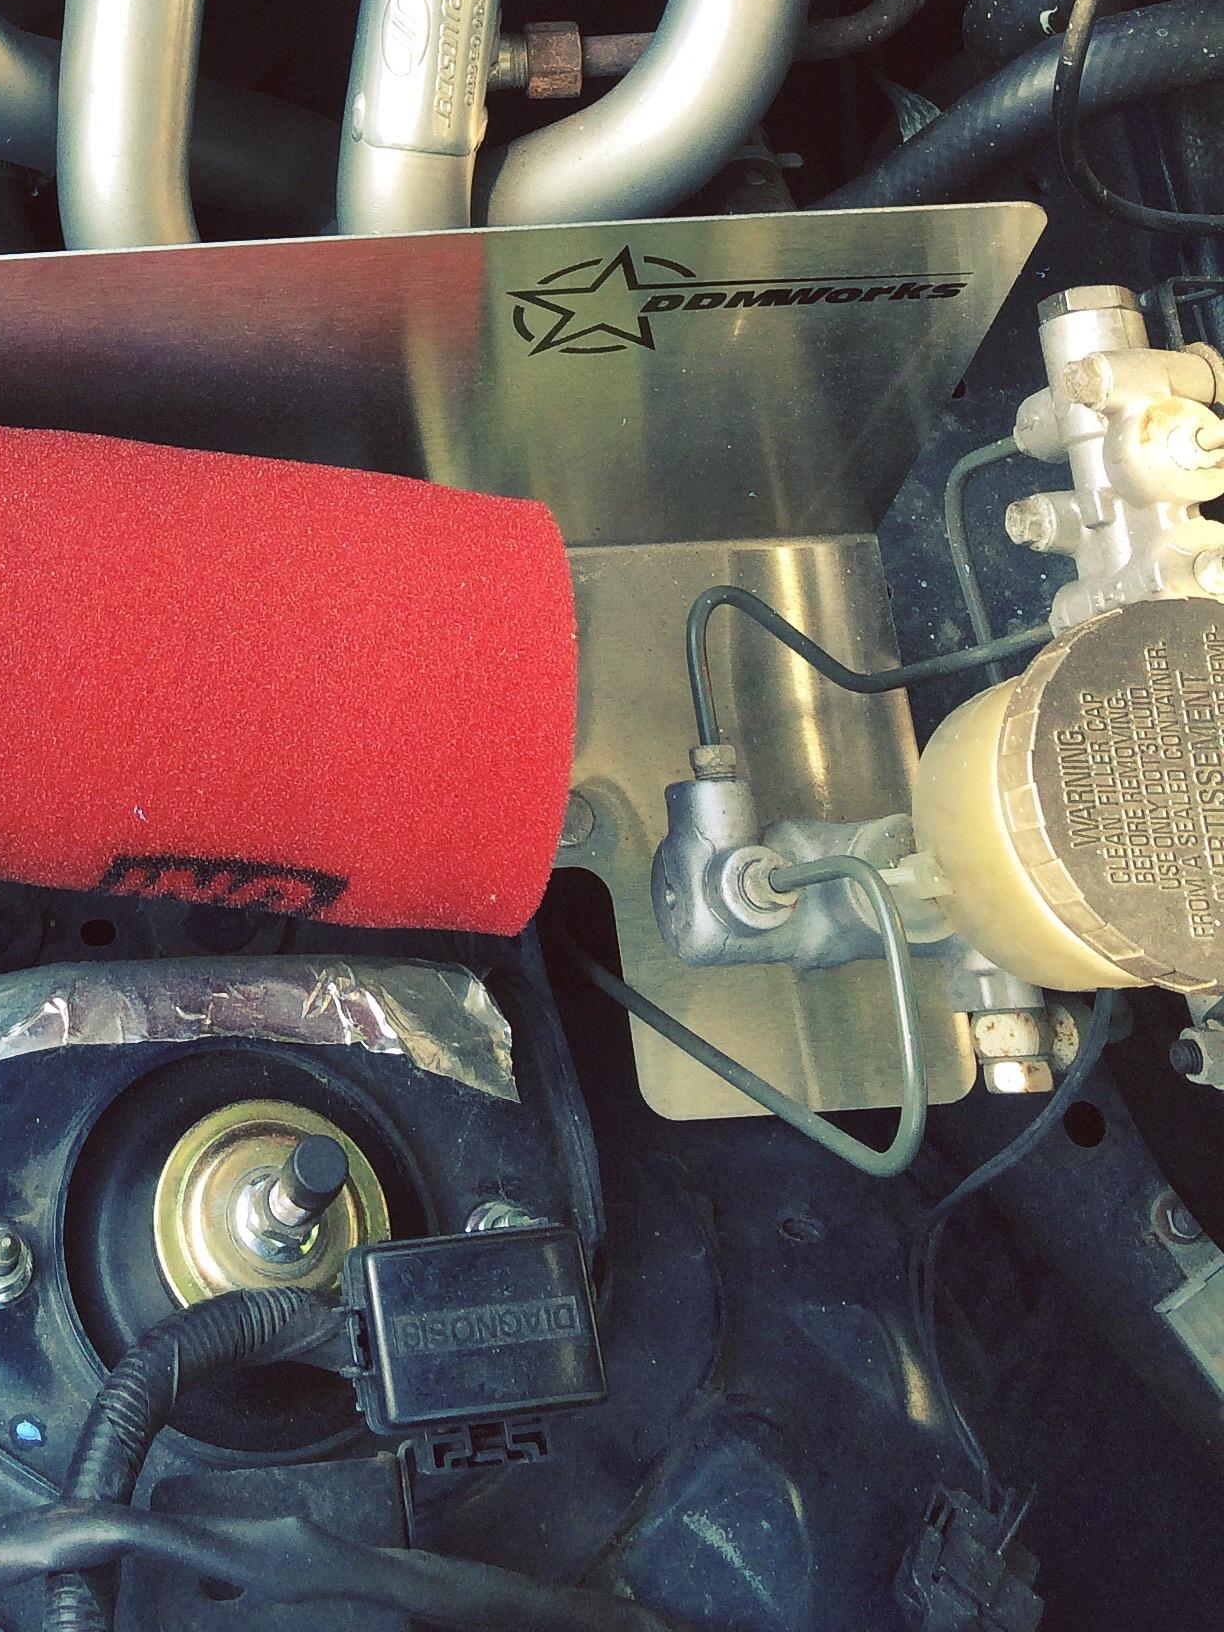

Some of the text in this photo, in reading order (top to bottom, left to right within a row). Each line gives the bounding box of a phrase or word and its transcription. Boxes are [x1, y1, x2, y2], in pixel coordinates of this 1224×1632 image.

[1080, 691, 1131, 884] CLEAN FILLER CAP
[1165, 769, 1198, 846] SEALED
[1122, 808, 1155, 884] BEFORE
[1145, 799, 1174, 848] ONLY
[1152, 851, 1181, 890] USE
[1179, 855, 1202, 869] A
[1182, 879, 1215, 937] FROM
[400, 1302, 575, 1348] DIAGNOSIS
